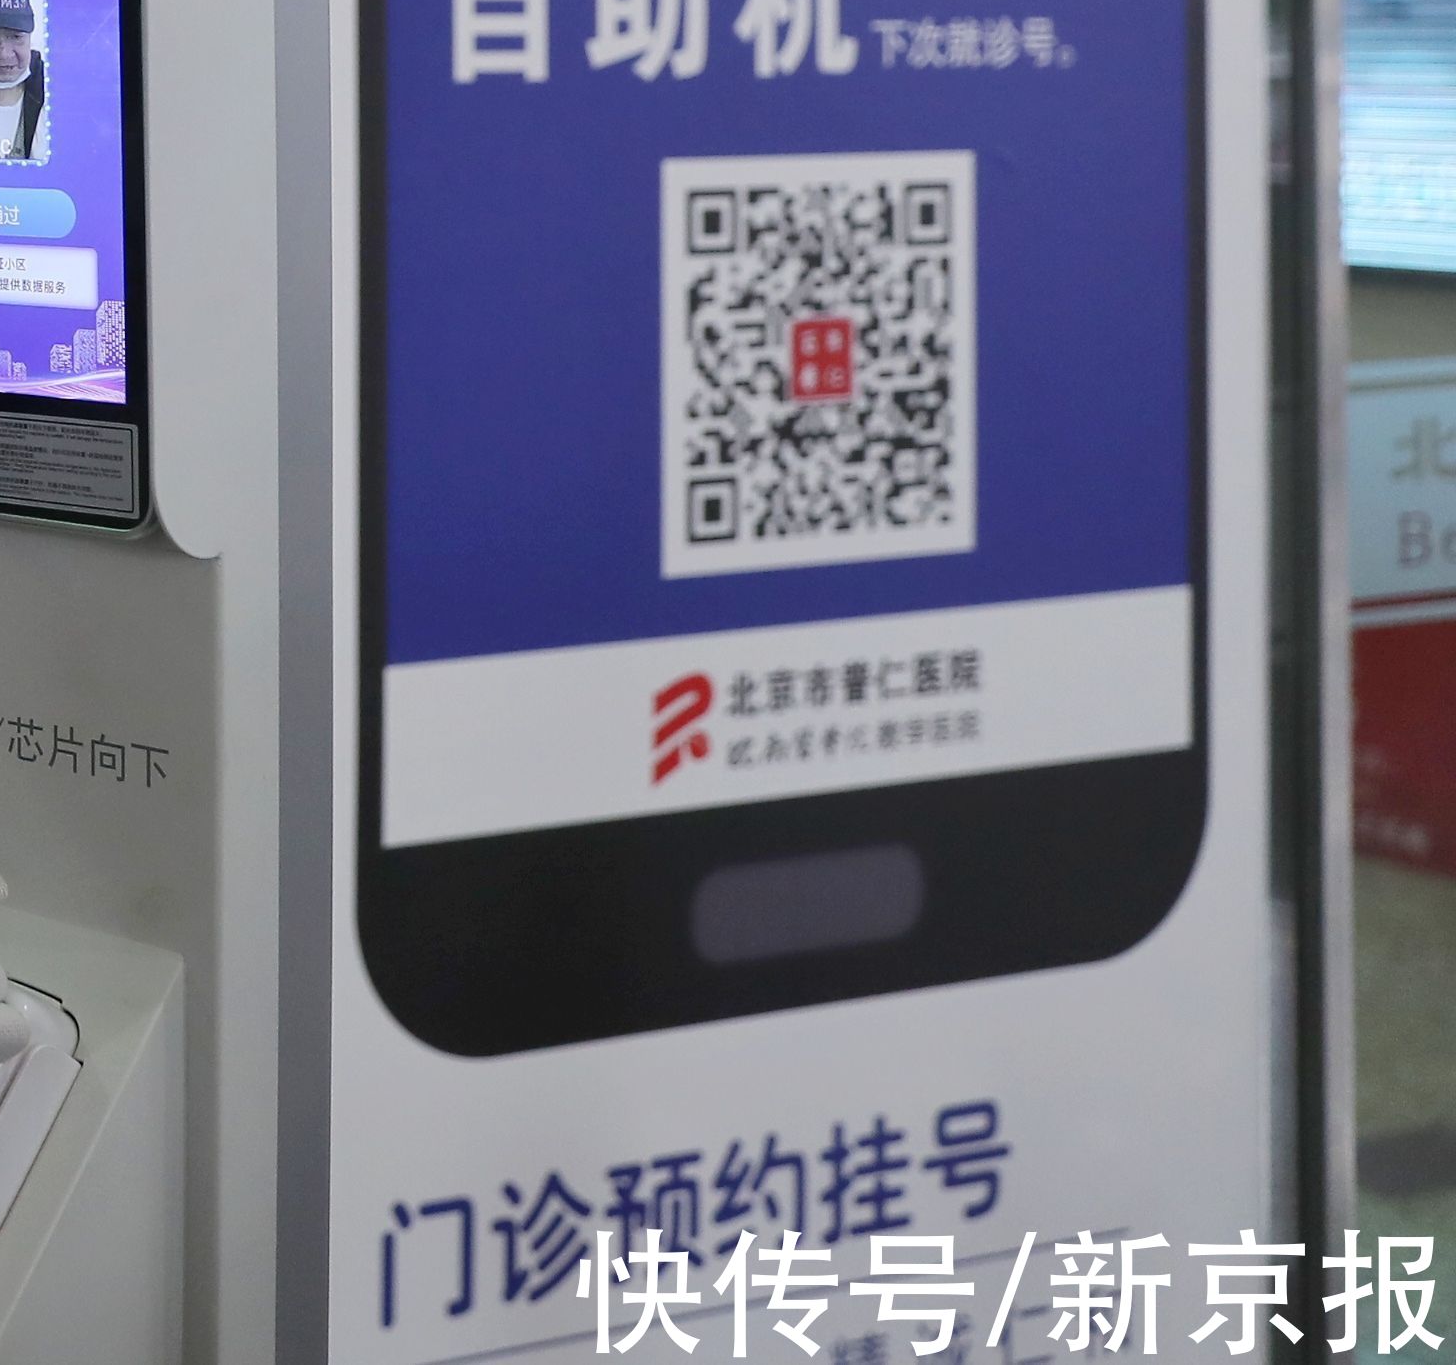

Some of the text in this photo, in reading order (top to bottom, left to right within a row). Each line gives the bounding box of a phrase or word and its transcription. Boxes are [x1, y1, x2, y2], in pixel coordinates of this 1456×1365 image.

[381, 1099, 1012, 1329] 门诊预约挂号
